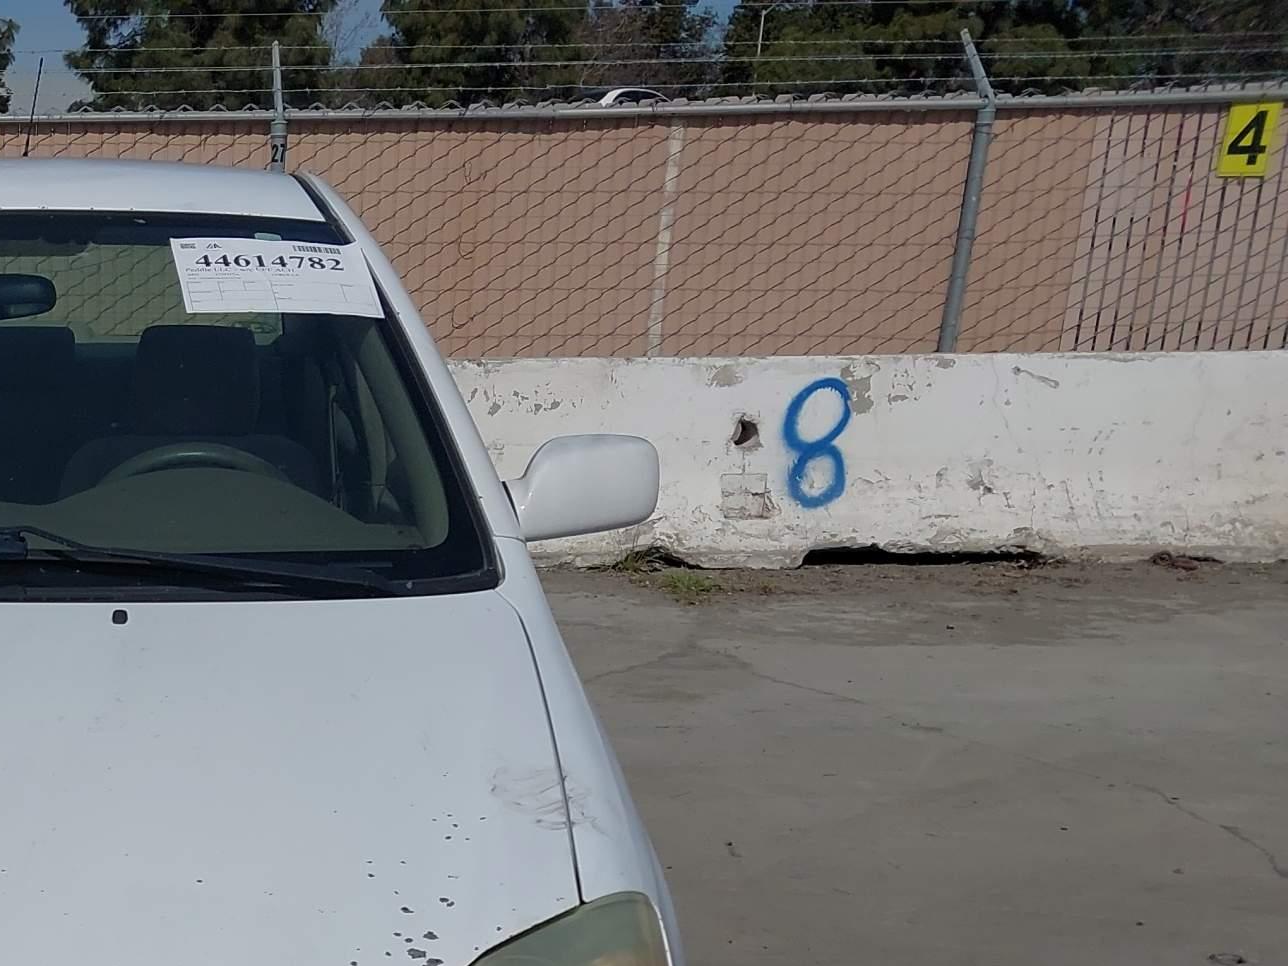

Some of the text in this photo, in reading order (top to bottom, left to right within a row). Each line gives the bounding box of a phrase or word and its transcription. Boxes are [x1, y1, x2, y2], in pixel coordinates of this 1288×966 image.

[271, 143, 286, 163] 27
[1227, 110, 1268, 165] 4
[195, 254, 344, 271] 44614782
[783, 377, 851, 509] 8
